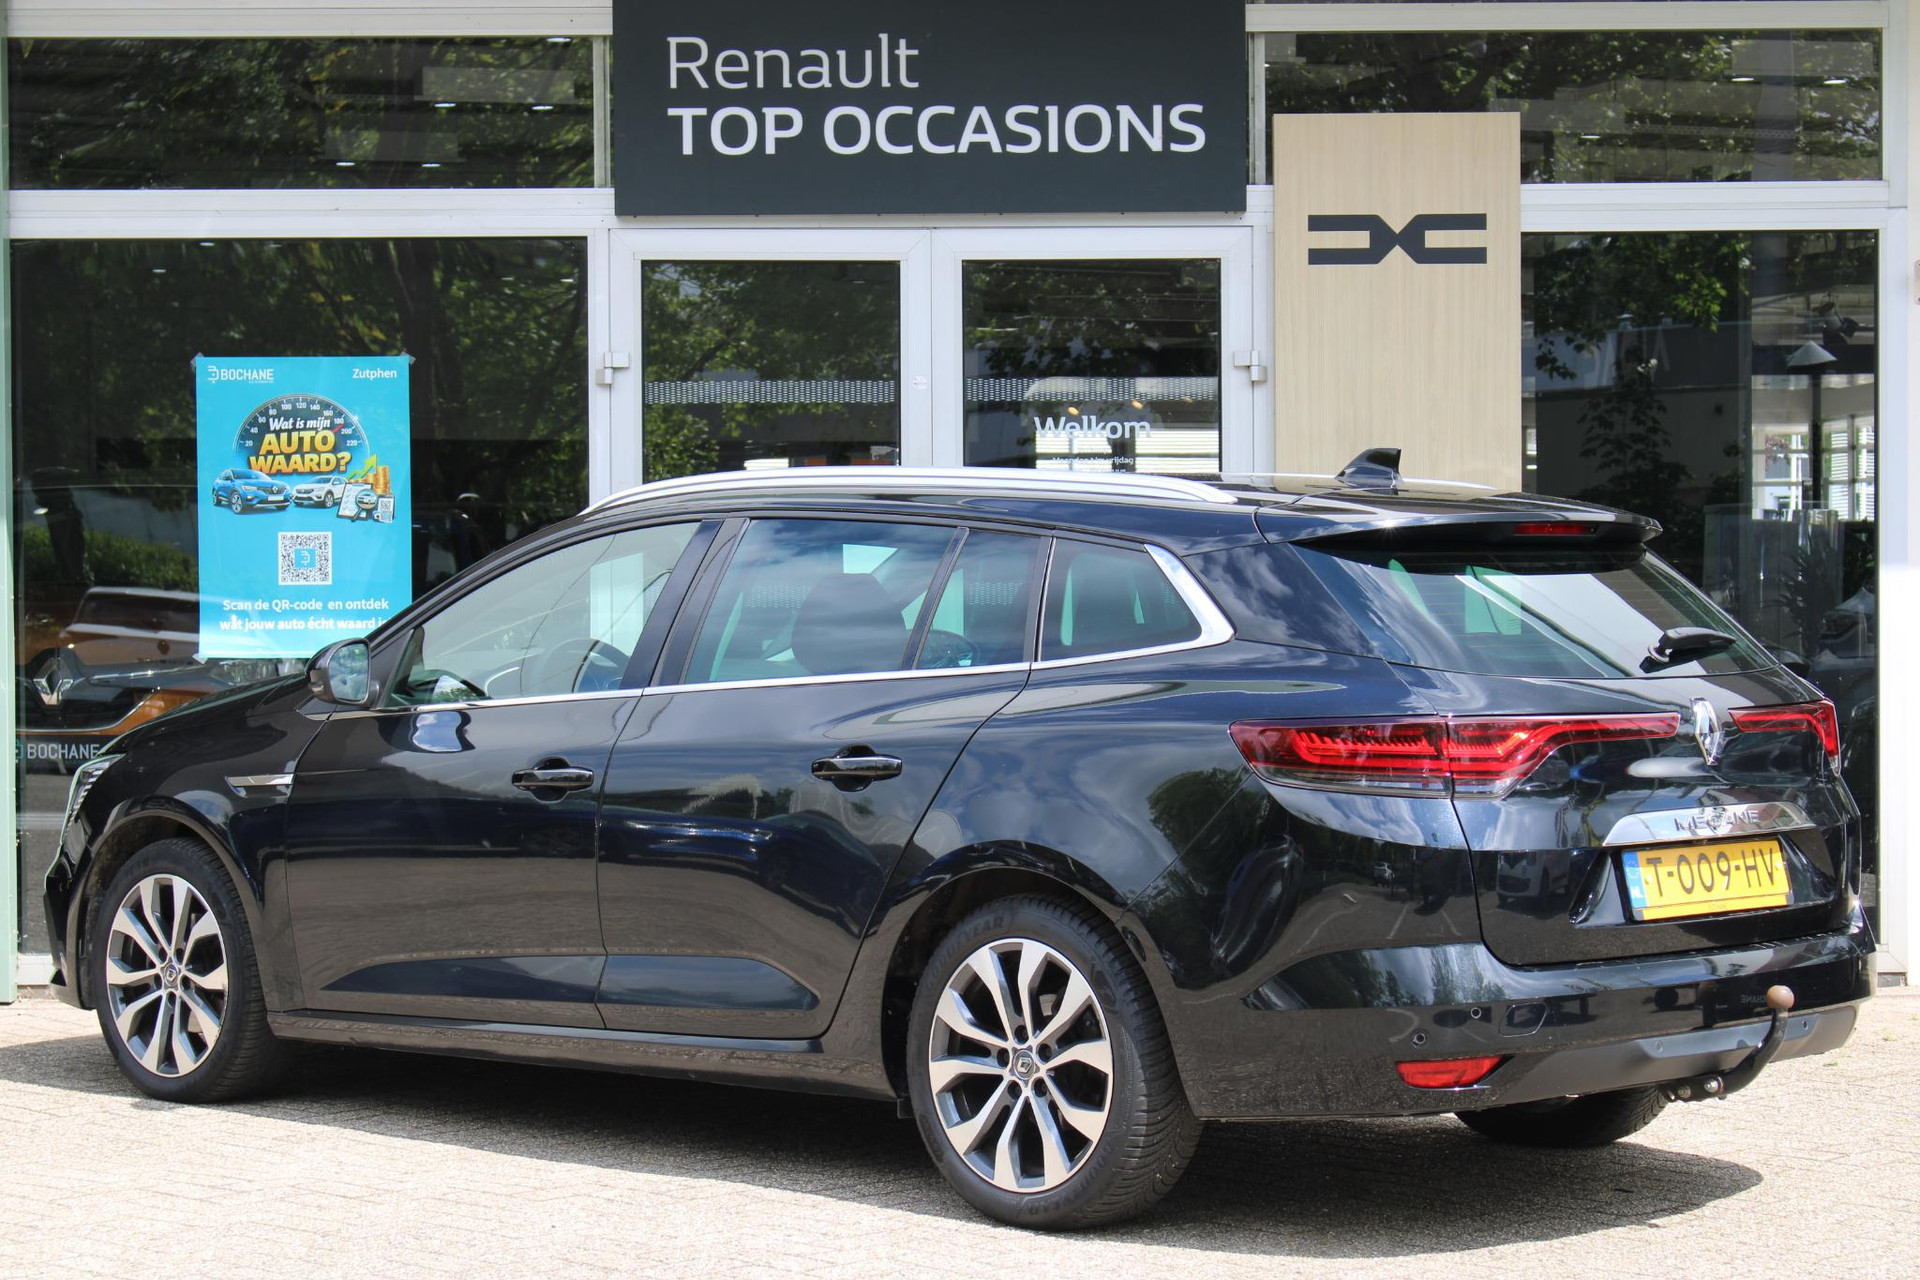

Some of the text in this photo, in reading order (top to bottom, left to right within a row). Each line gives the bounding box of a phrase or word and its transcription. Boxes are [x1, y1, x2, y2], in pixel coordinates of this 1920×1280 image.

[667, 33, 919, 90] Renault
[667, 103, 1206, 156] TOP OCCASIONS
[220, 368, 275, 381] BOCHANE
[352, 367, 398, 381] Zutphen
[268, 408, 277, 416] 80
[269, 416, 331, 431] Wat is mijn
[1033, 415, 1152, 439] Welkom
[259, 430, 336, 456] AUTO
[249, 452, 352, 474] WAARD?
[223, 598, 389, 613] Scan de QR-code en ontdek
[219, 618, 243, 631] wat
[244, 617, 275, 632] jouw
[277, 618, 306, 630] auto
[307, 615, 334, 630] écht
[337, 616, 376, 630] waard
[27, 743, 100, 760] BOCHANE
[1646, 847, 1776, 897] T-009-HV
[1630, 886, 1643, 900] NL
